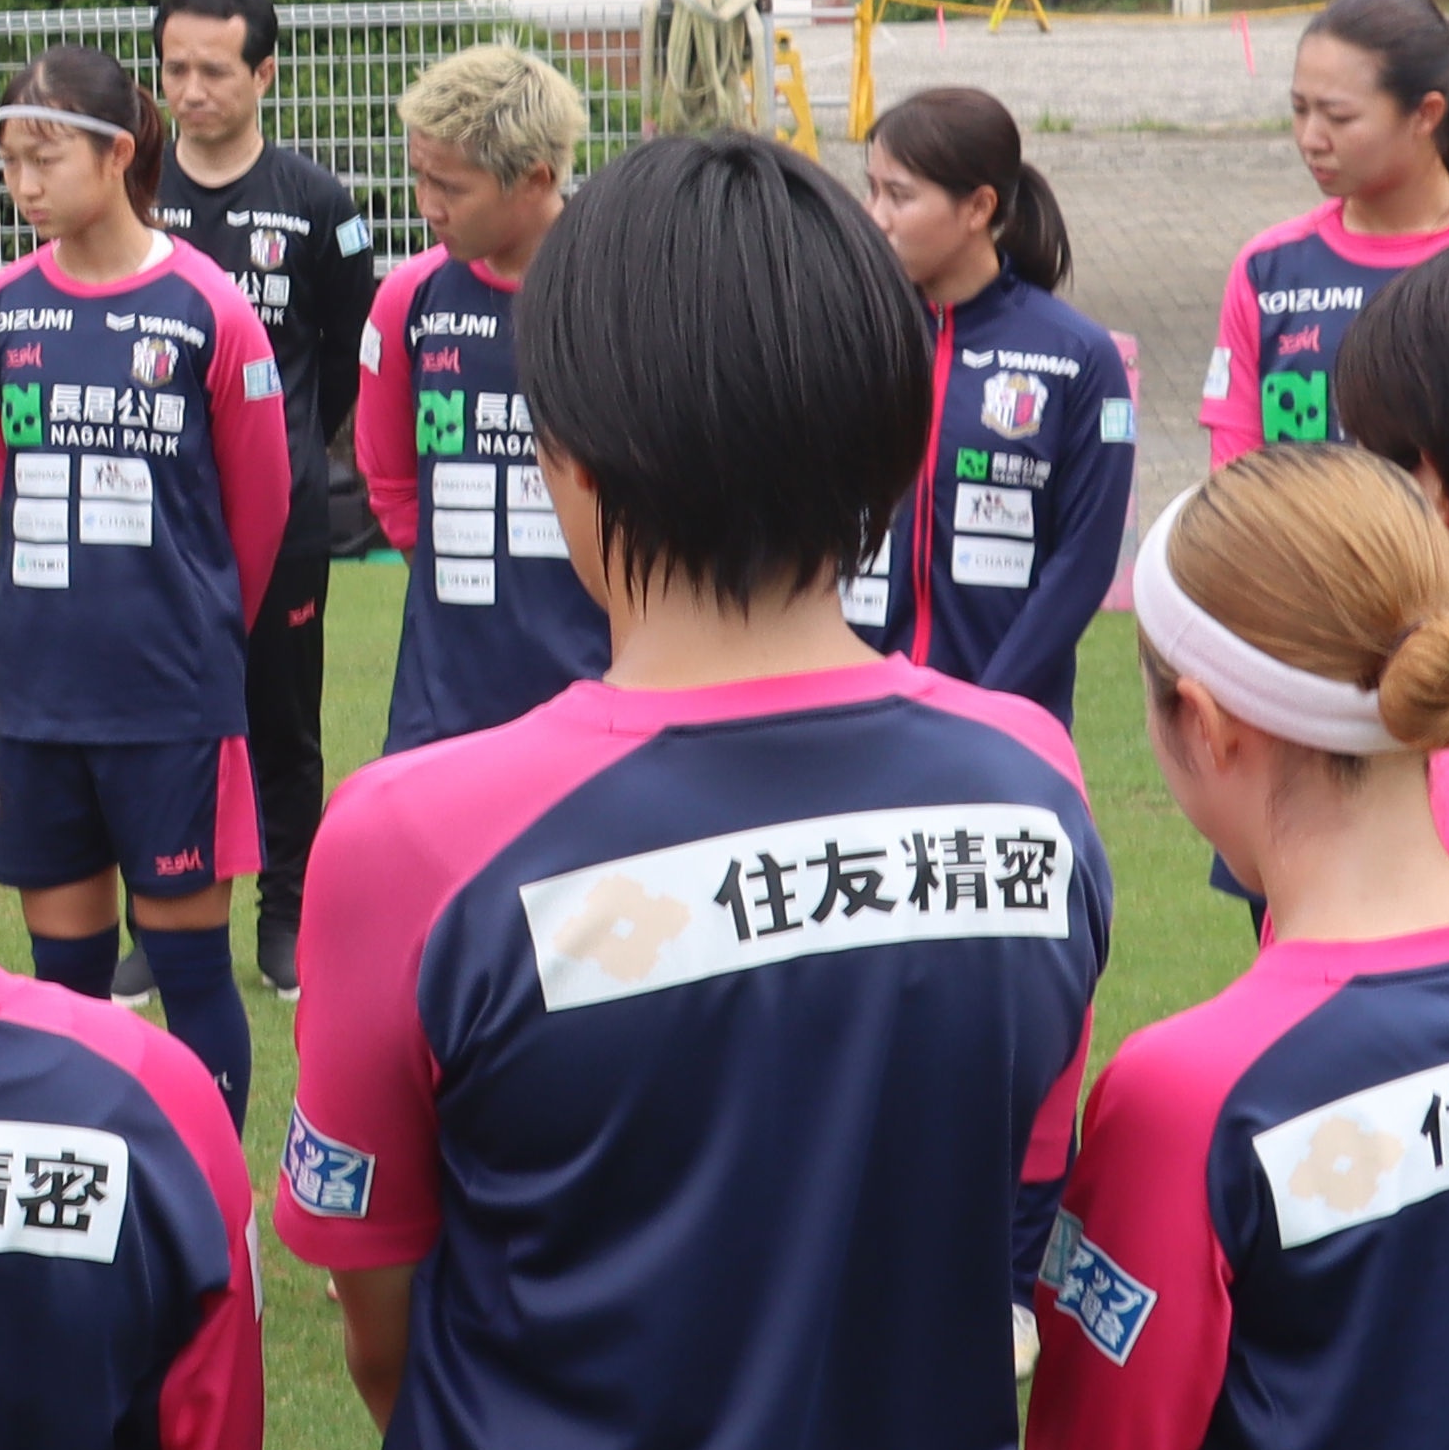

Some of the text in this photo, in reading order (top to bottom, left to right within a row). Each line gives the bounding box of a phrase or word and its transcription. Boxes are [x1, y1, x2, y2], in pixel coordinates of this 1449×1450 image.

[228, 270, 290, 307] 公園
[50, 384, 186, 434] 長居公園
[51, 424, 179, 458] NAGAI PARK
[712, 826, 1058, 944] 住友精密
